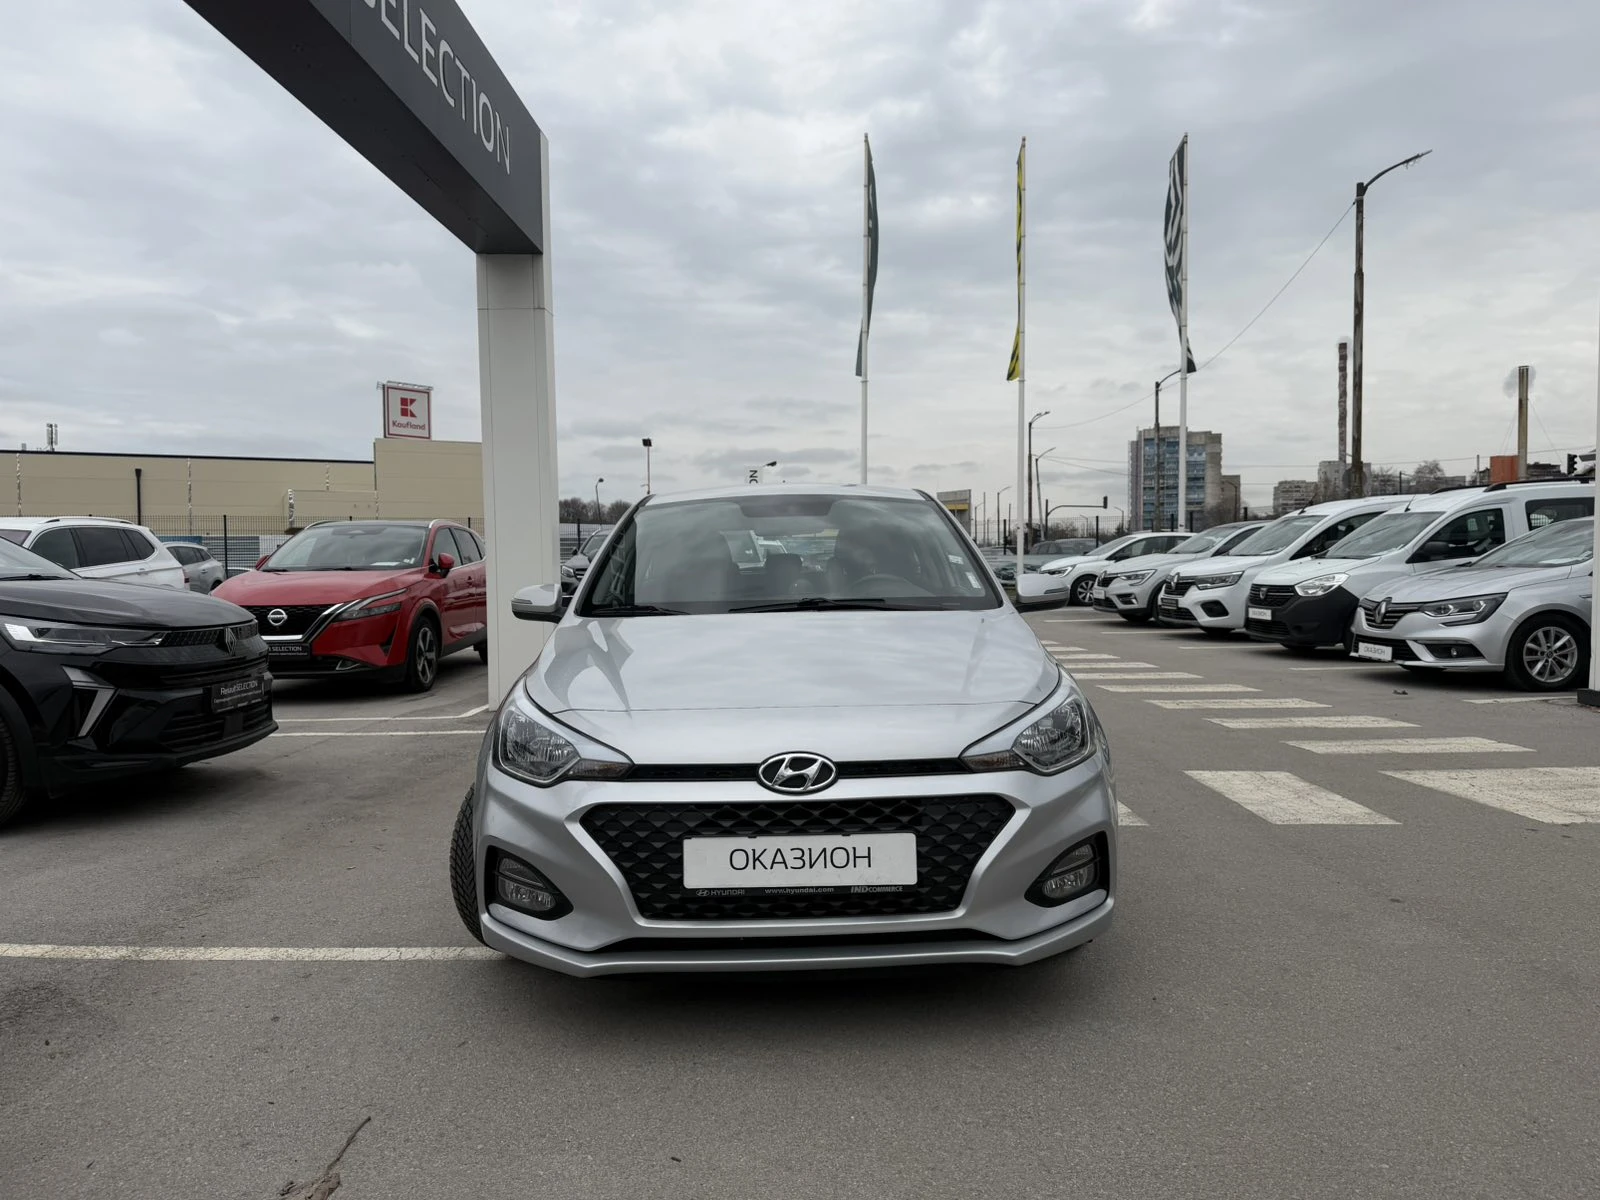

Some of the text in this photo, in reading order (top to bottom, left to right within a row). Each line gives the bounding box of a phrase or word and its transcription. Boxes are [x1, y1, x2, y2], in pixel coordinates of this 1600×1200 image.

[364, 0, 511, 175] LECTION
[392, 420, 426, 431] Kaufland
[729, 846, 872, 871] ОКАЗИОН
[710, 888, 745, 896] HYUNDAI
[764, 887, 834, 895] www.hyundai.com
